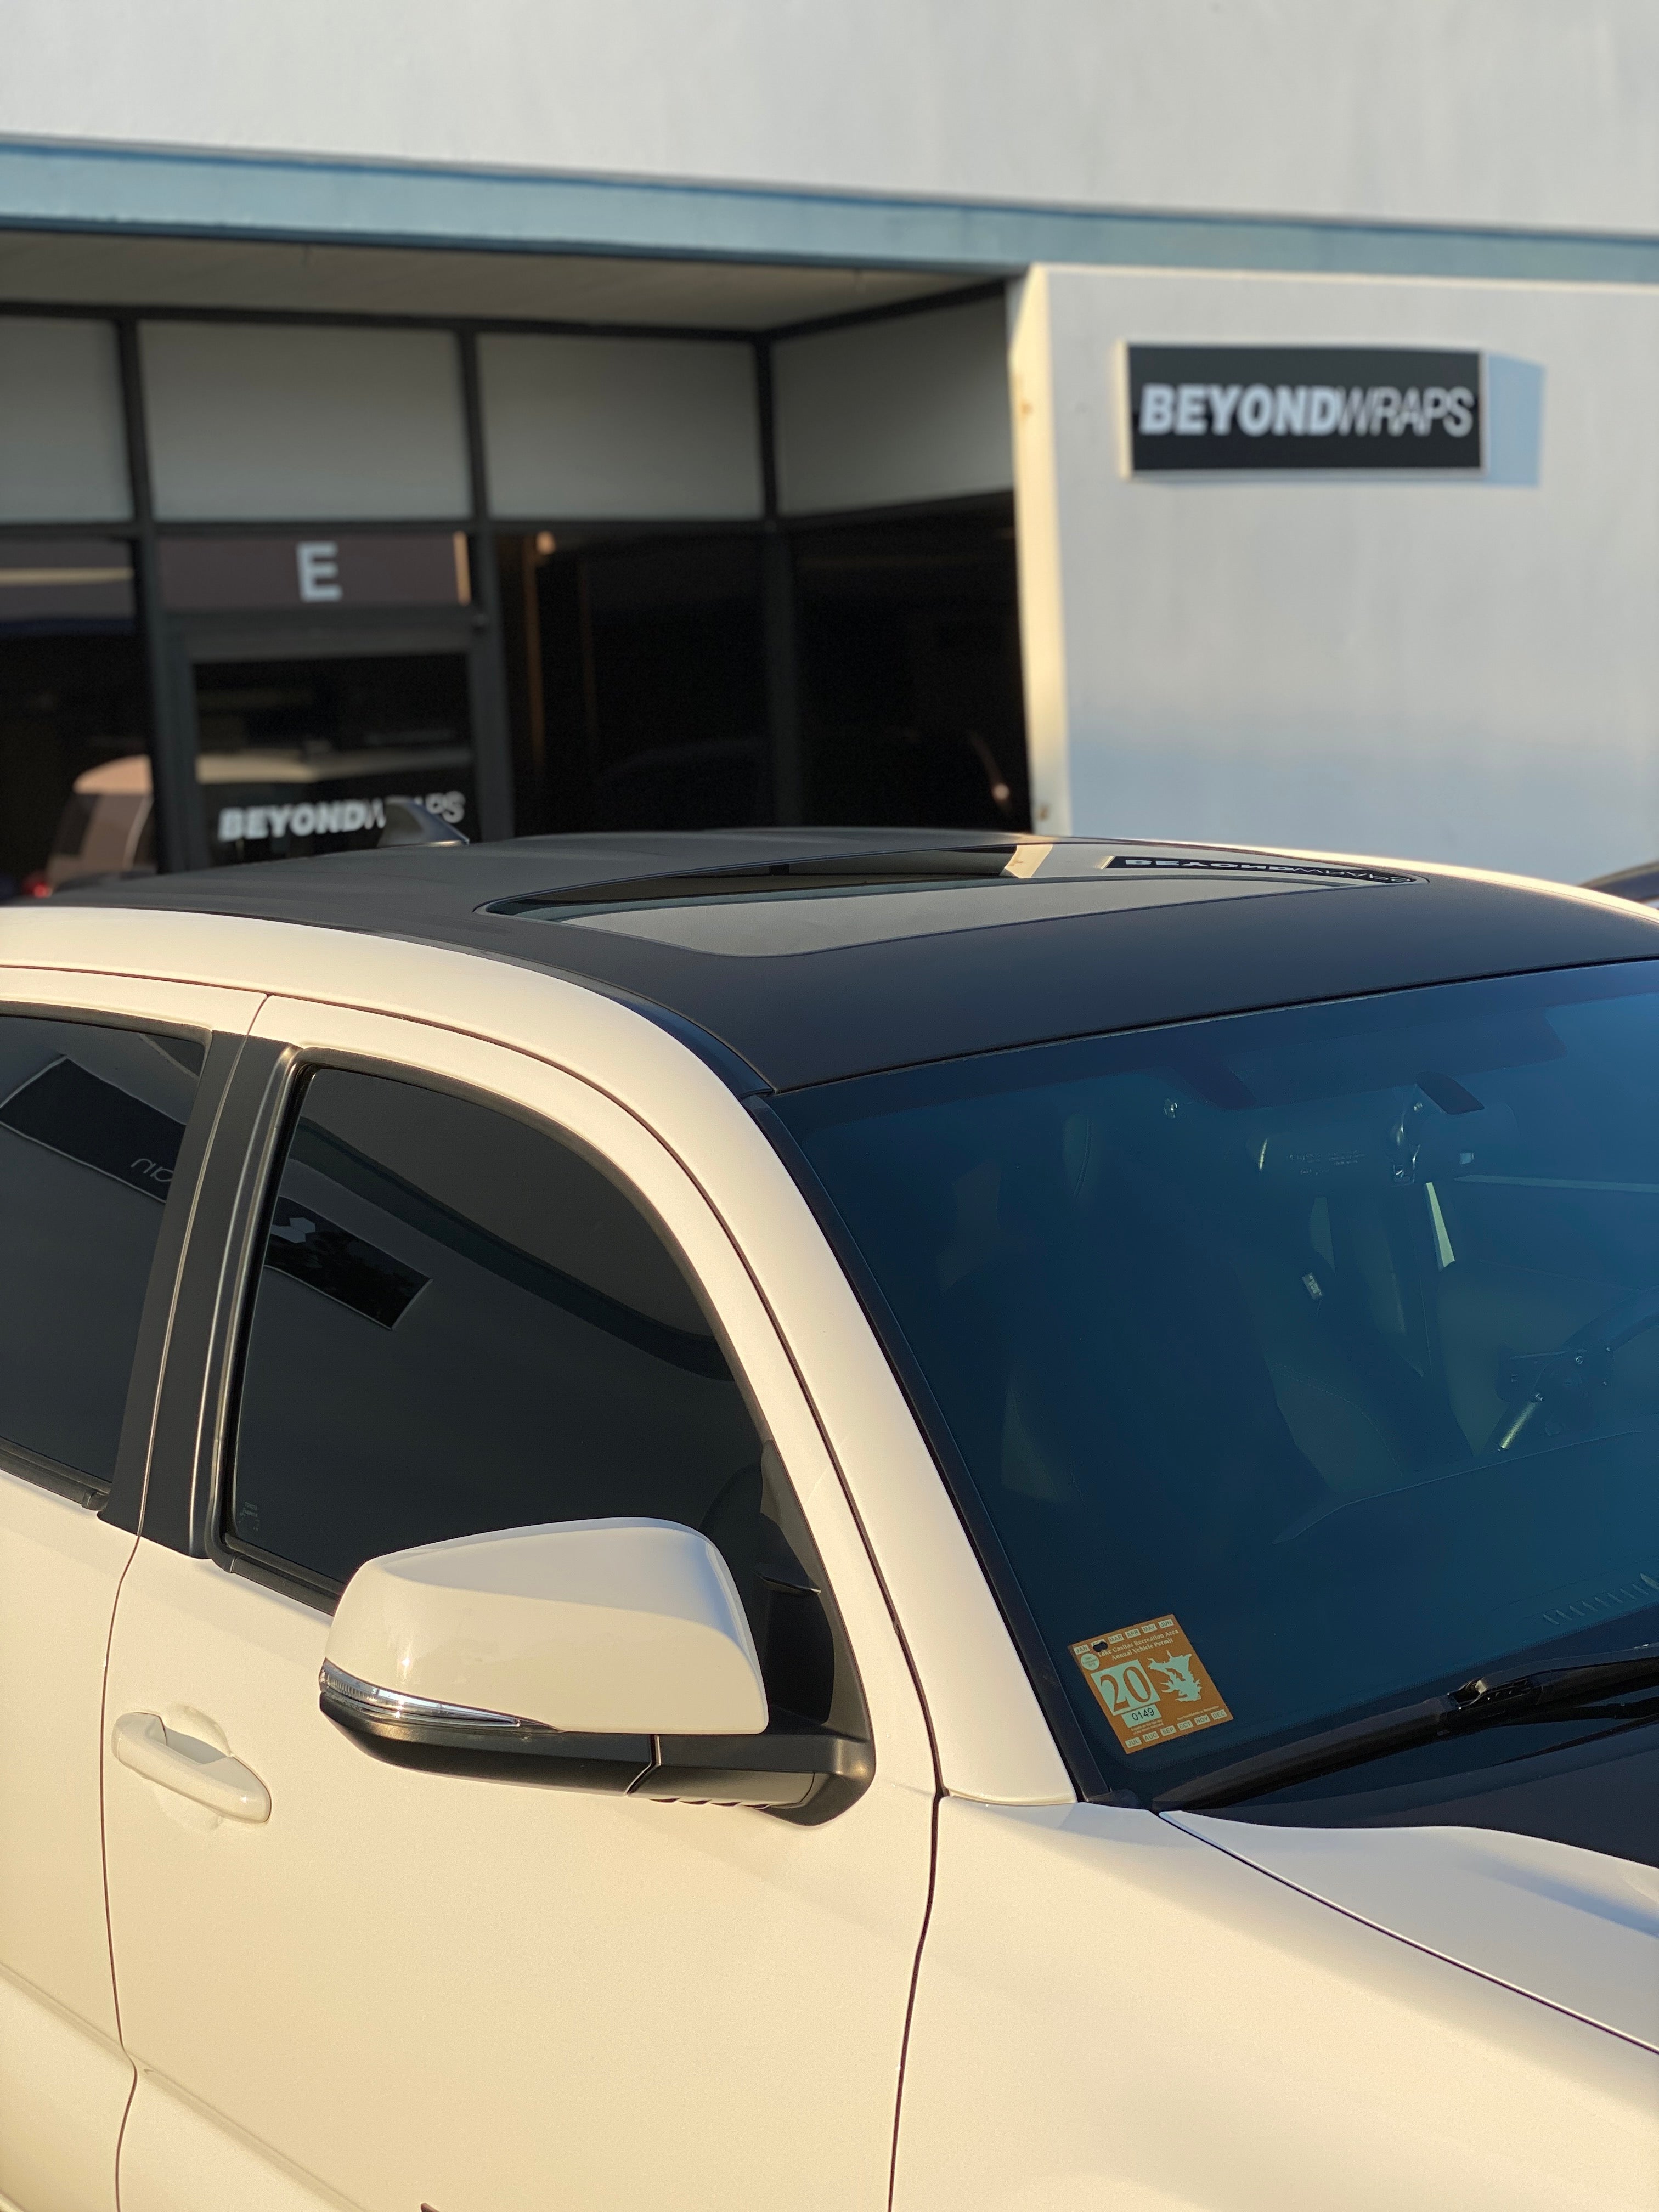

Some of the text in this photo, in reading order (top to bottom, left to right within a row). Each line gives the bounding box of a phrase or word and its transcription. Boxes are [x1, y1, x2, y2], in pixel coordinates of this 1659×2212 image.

[1139, 383, 1475, 438] BEYONDWRAPS
[296, 541, 342, 602] E
[1111, 1638, 1173, 1661] Annual Vehicle Permit
[1134, 1634, 1164, 1646] Recreation
[1099, 1666, 1152, 1712] 20
[1132, 1708, 1154, 1720] 0149
[1128, 1739, 1140, 1747] JUL
